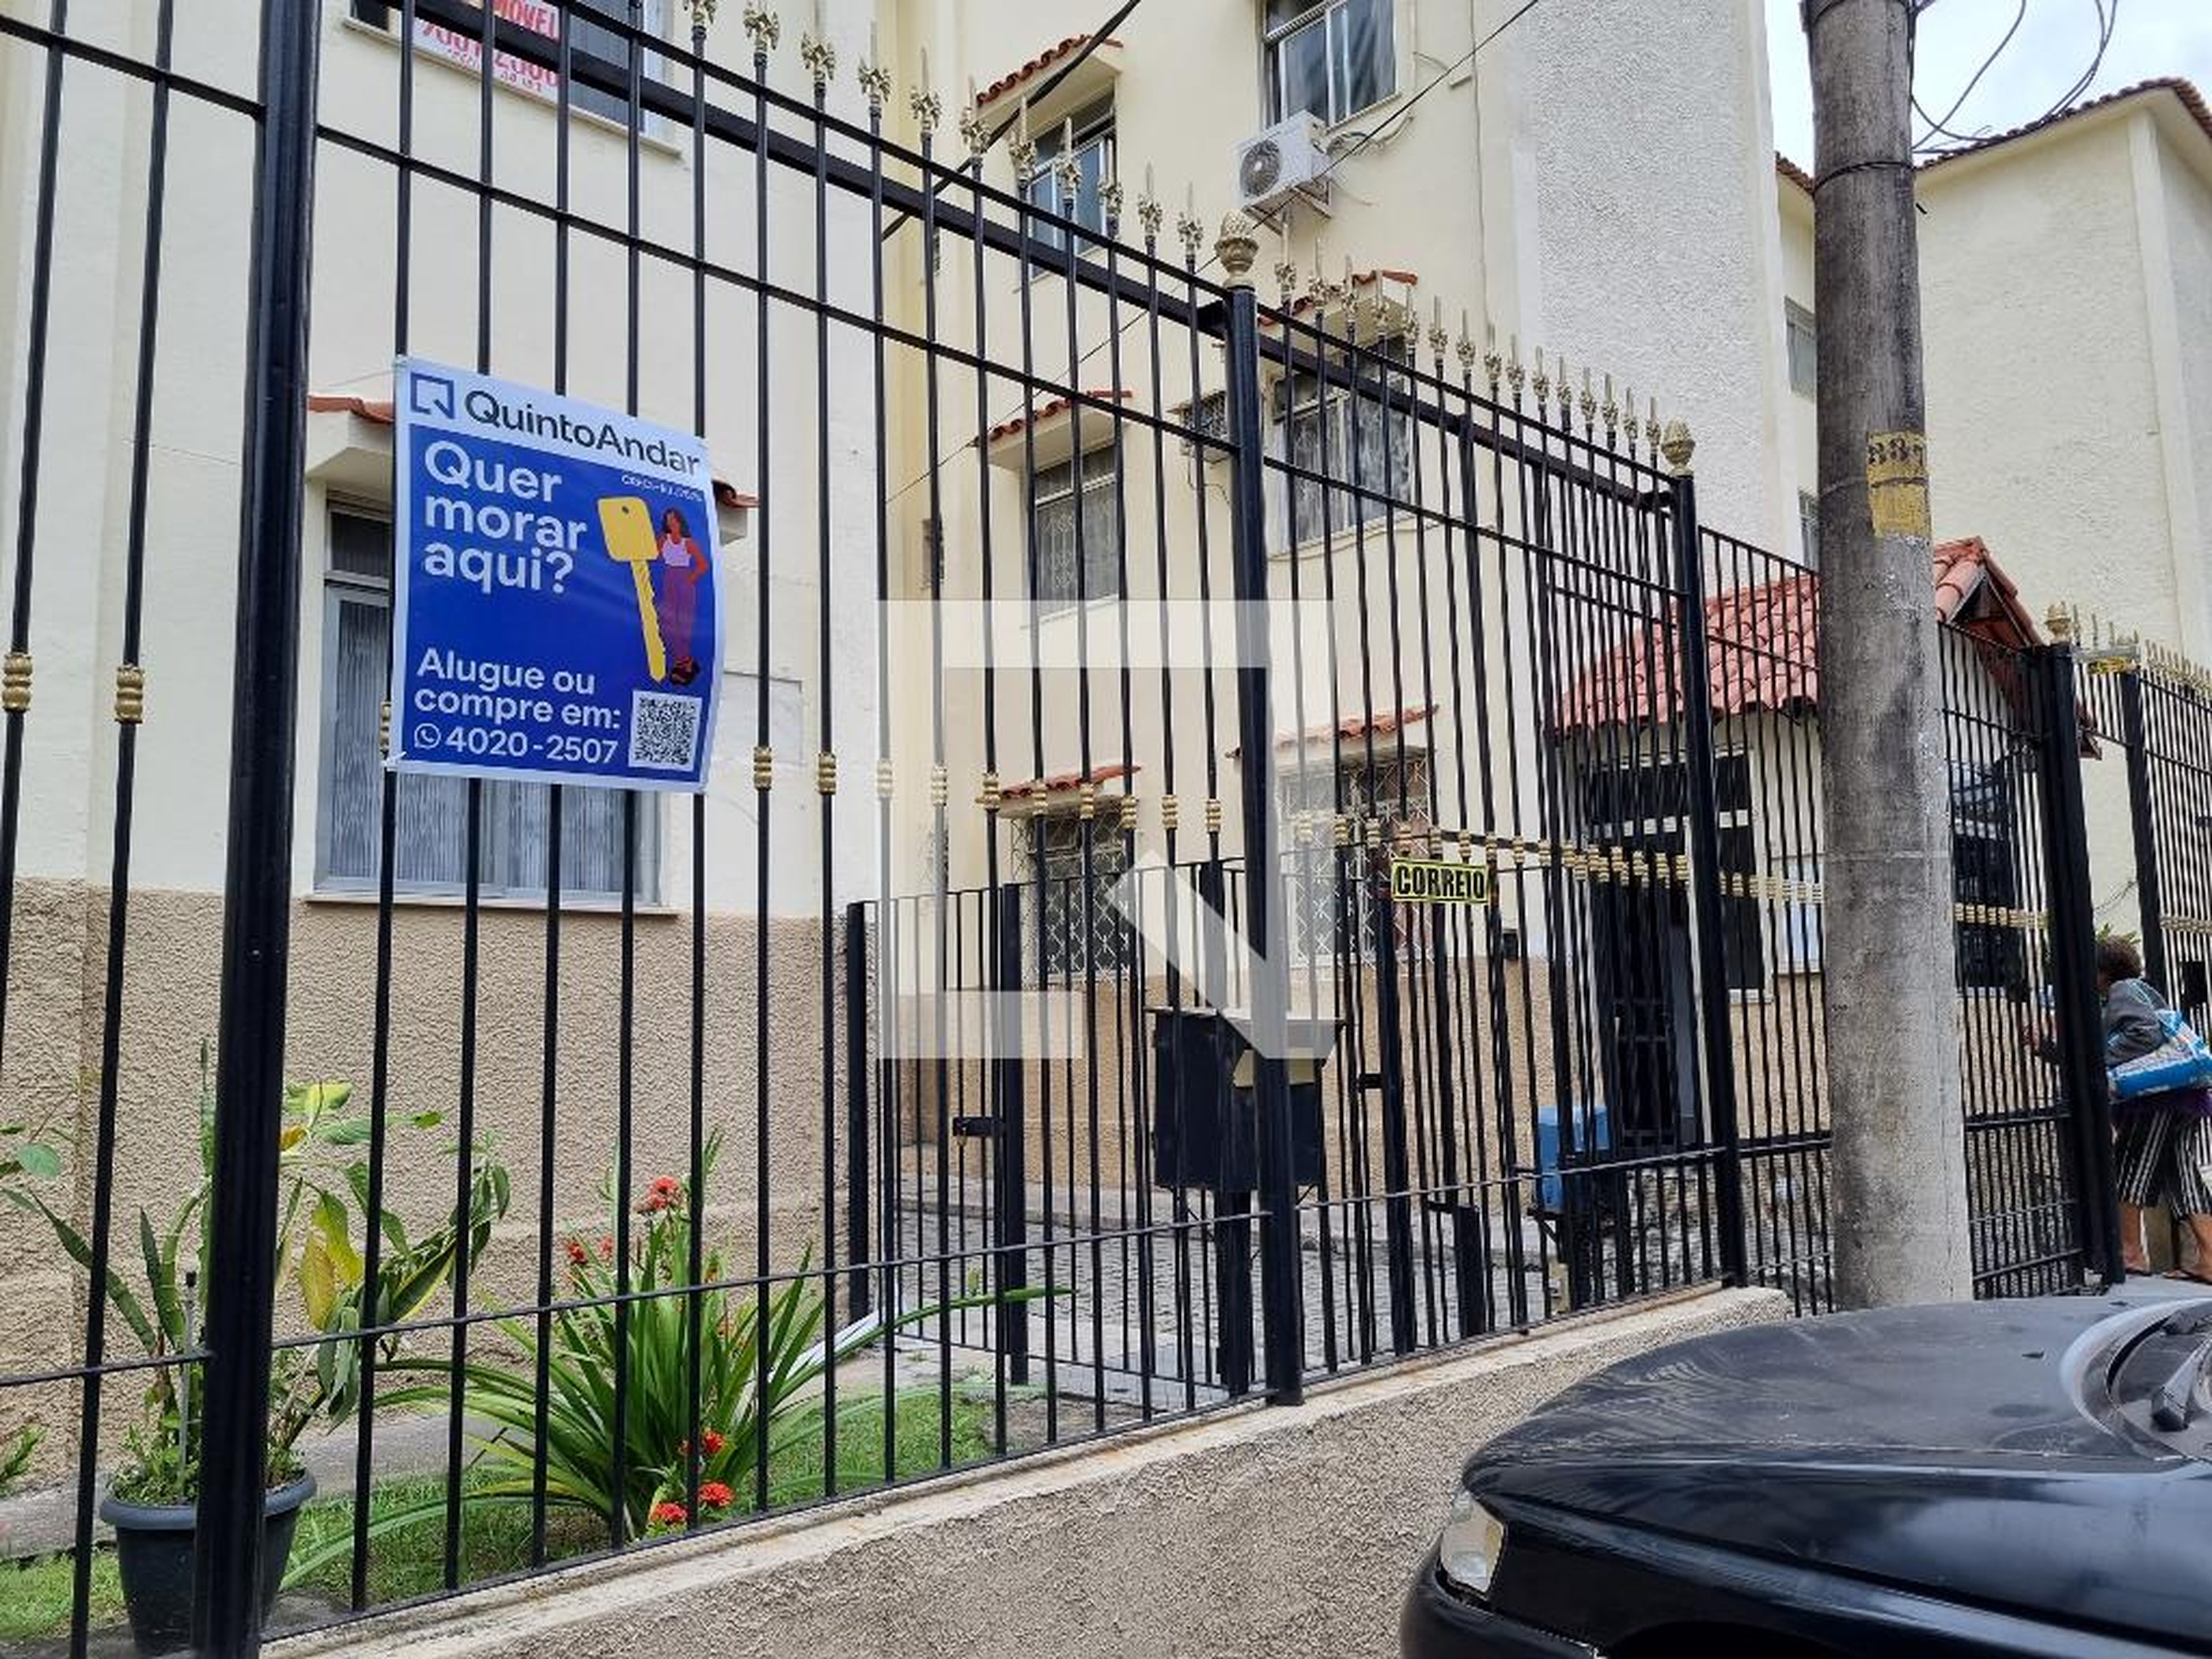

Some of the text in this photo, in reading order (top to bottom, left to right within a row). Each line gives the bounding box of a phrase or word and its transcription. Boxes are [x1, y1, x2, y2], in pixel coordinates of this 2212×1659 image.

[465, 390, 700, 475] QuintoAndar
[425, 441, 562, 502] Quer
[425, 496, 588, 550] morar
[425, 542, 573, 594] aqui?
[416, 647, 595, 695] Alugue ou
[414, 689, 621, 729] compre em:
[446, 726, 619, 763] 4020-2507
[1396, 865, 1485, 899] CORREIO
